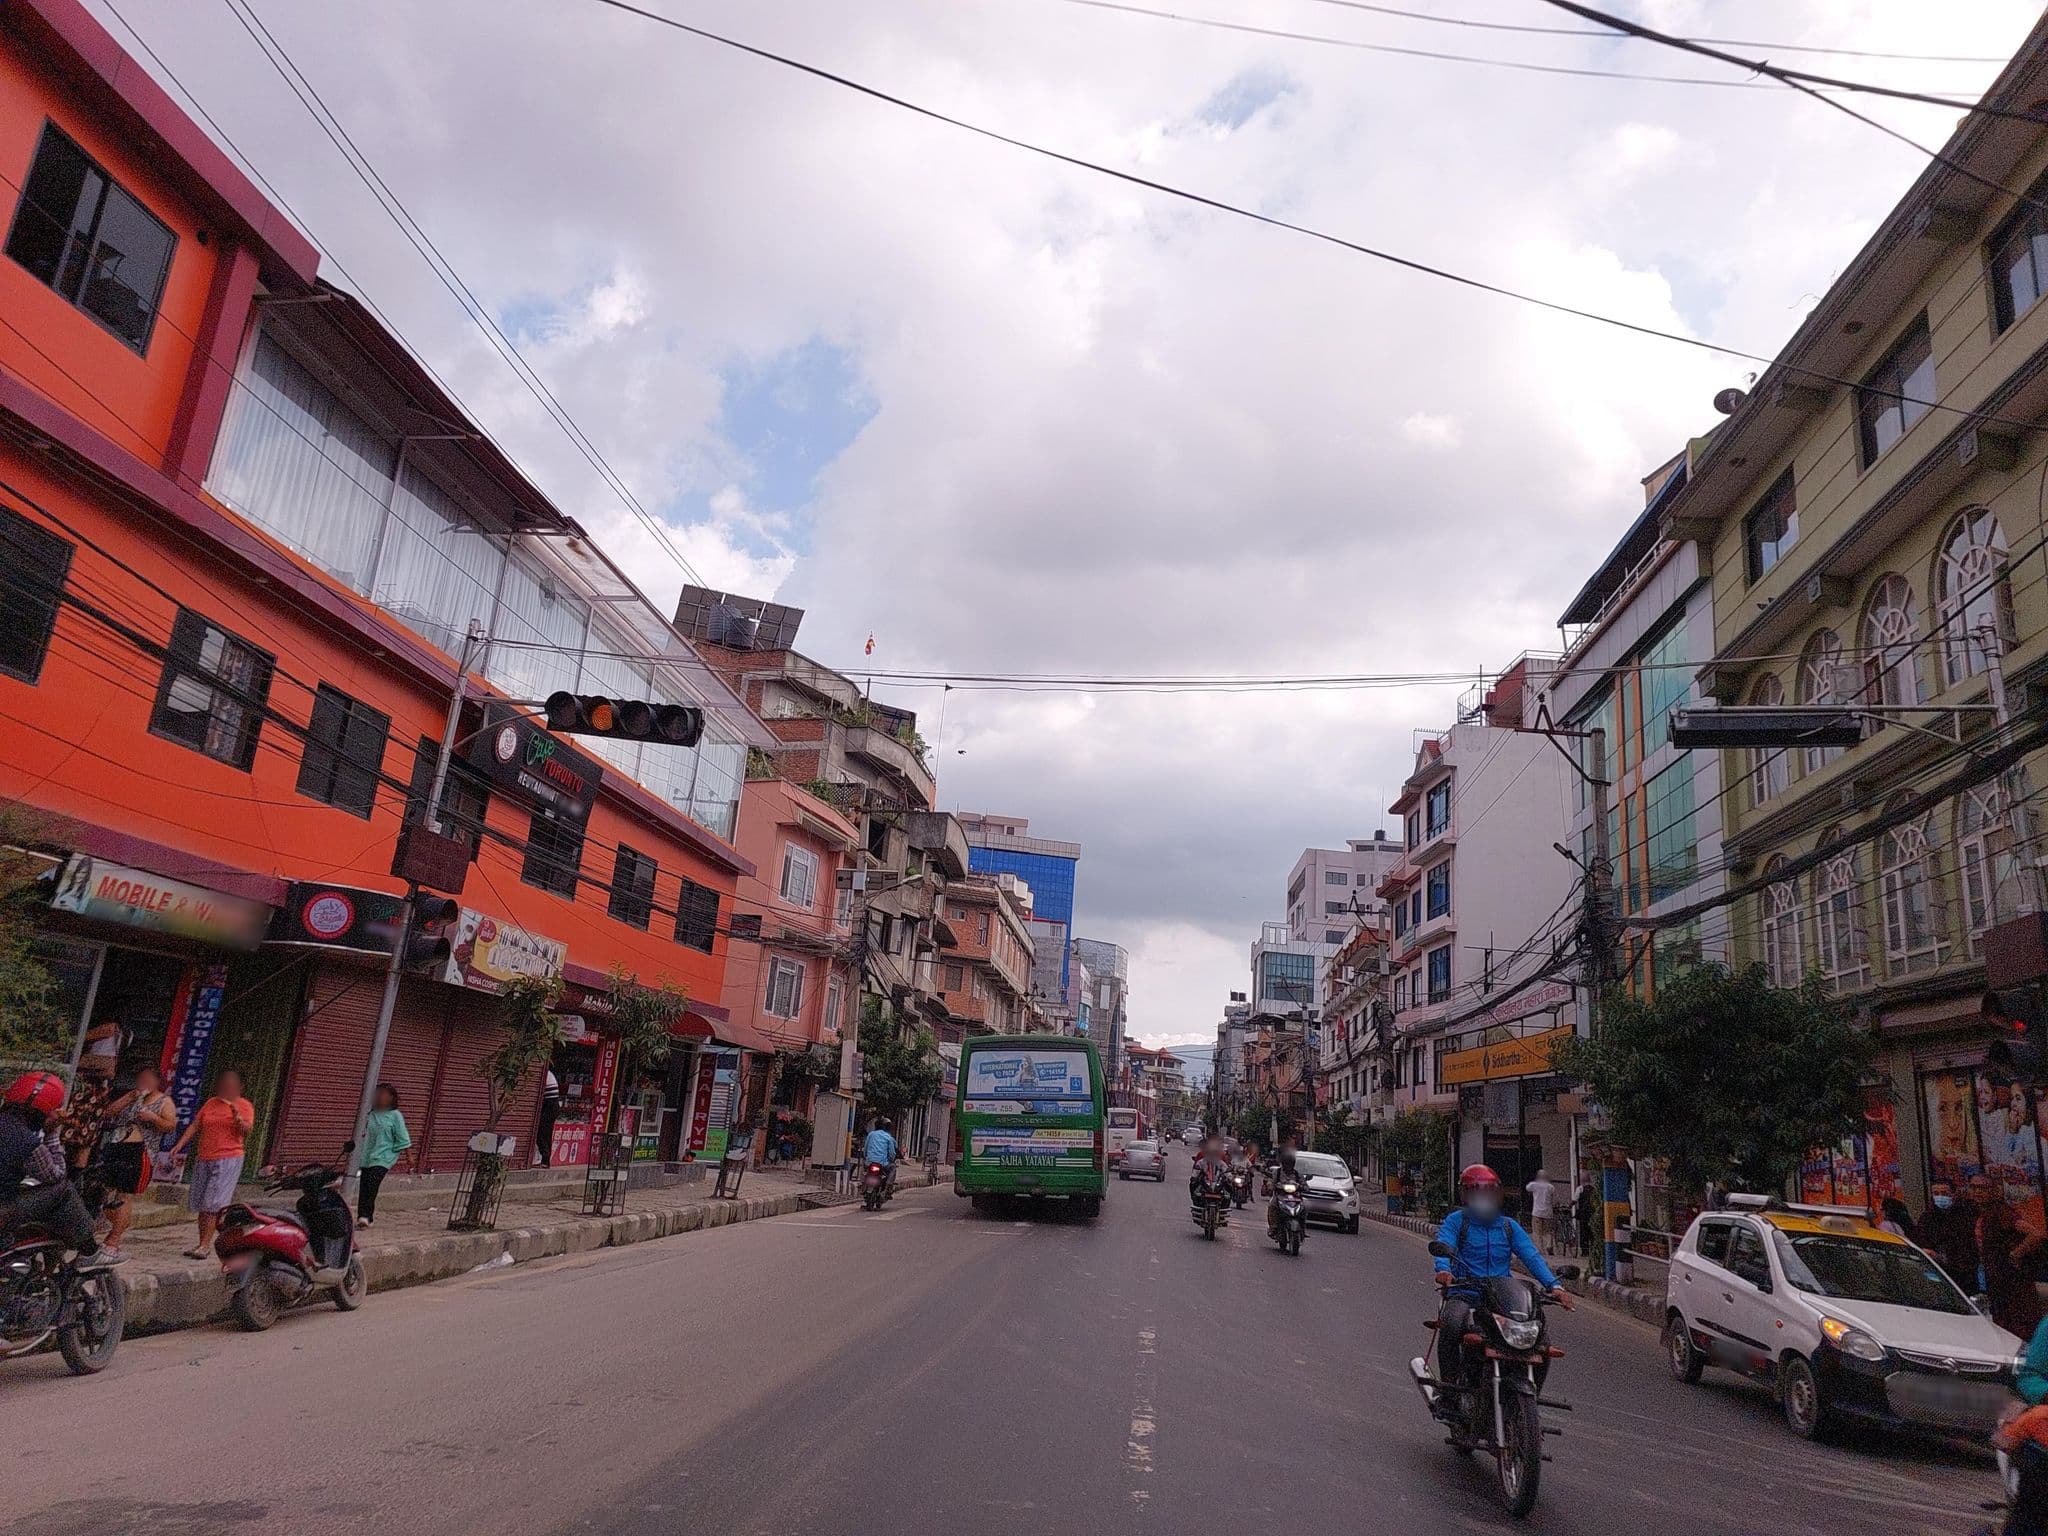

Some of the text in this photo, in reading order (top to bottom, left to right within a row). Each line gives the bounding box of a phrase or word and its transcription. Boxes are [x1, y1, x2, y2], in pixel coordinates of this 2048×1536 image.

[97, 875, 174, 912] MOBILE
[600, 1041, 616, 1097] MOBILE
[693, 1067, 714, 1136] DAIRY
[1001, 1155, 1055, 1166] SAJHA YATAYAT
